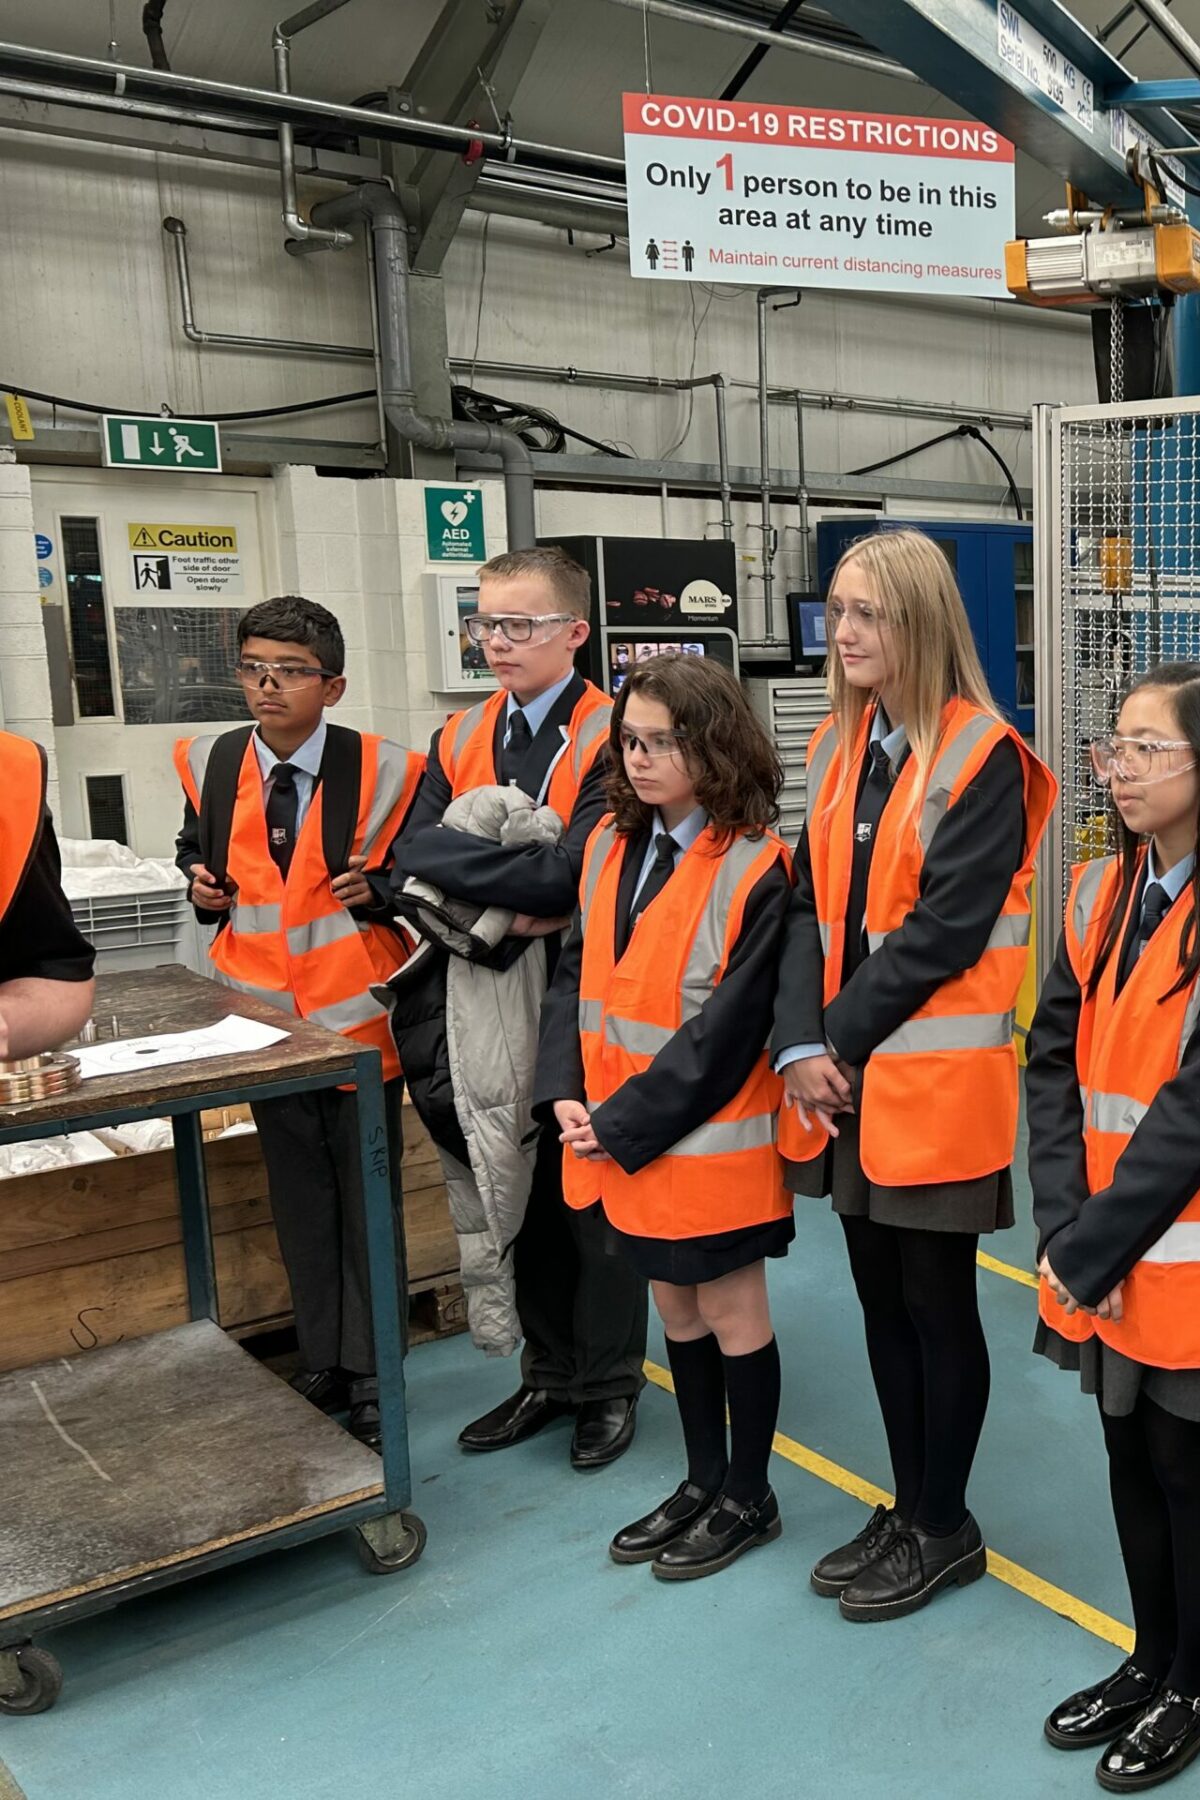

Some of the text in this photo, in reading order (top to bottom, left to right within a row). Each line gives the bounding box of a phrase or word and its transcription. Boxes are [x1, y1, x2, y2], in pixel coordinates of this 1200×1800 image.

[1000, 1, 1022, 44] SWL
[1042, 43, 1057, 73] 500
[1063, 60, 1076, 89] KG
[1000, 34, 1025, 72] Serial
[641, 102, 999, 153] COVID-19 RESTRICTIONS
[646, 152, 997, 209] Only 1 person to be in this
[719, 207, 932, 239] area at any time
[709, 248, 1003, 280] Maintain current distancing measures
[14, 402, 28, 434] COOLANT
[158, 529, 234, 548] Caution
[442, 528, 470, 540] AED
[172, 556, 239, 565] Foot traffic other
[186, 576, 208, 584] Open
[688, 595, 717, 604] MARS
[368, 1126, 387, 1177] SKIP
